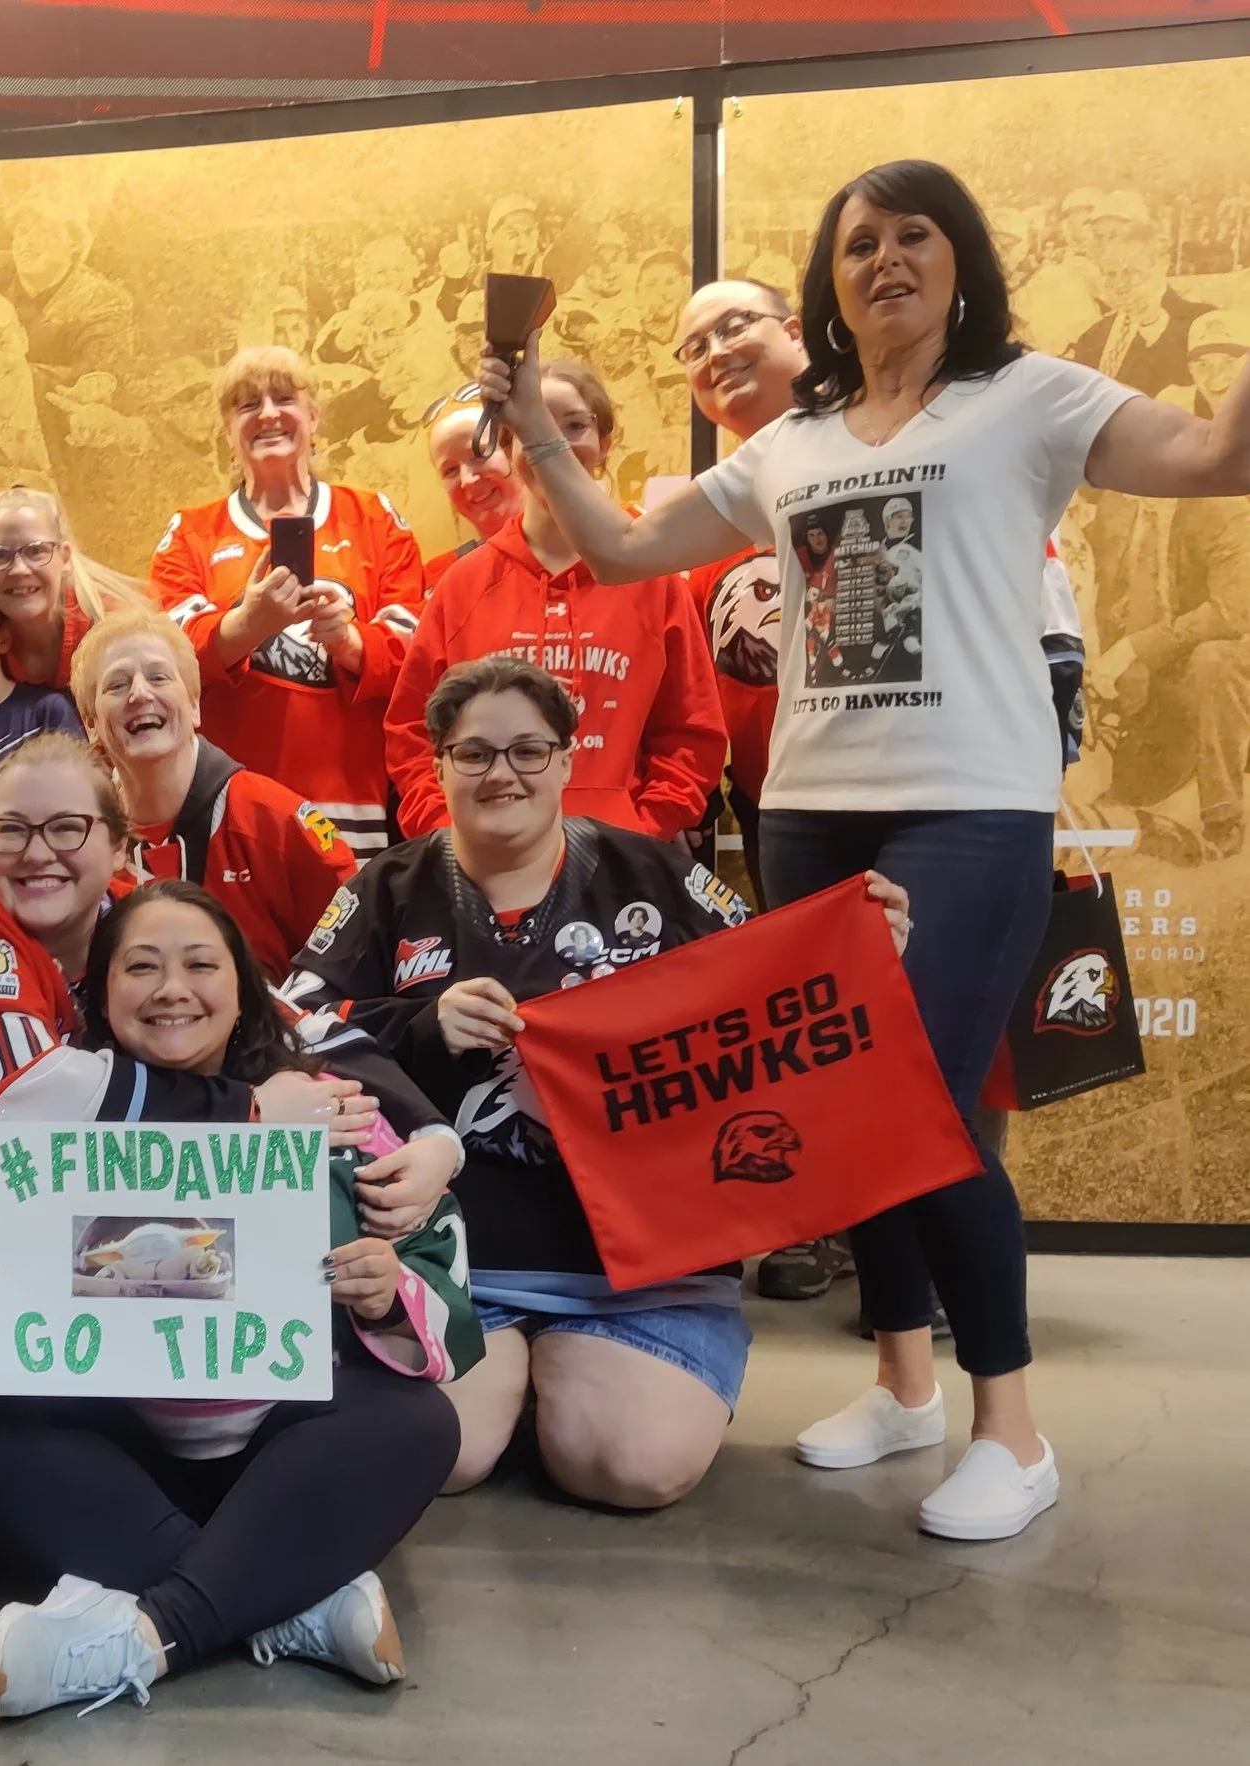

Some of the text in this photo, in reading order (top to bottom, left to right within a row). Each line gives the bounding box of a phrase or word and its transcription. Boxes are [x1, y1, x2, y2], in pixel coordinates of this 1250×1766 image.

[775, 463, 946, 514] KEEP ROLLIN'!!!
[483, 644, 630, 681] NTERHAWKS
[821, 696, 841, 711] GO
[845, 690, 942, 711] HAWKS!!!
[591, 940, 661, 965] CCM
[1126, 946, 1206, 963] CORD)
[595, 972, 840, 1085] LET'S GO
[1133, 997, 1197, 1037] 020
[603, 1003, 875, 1132] HAWKS!
[14, 1311, 314, 1381] GO TIPS
